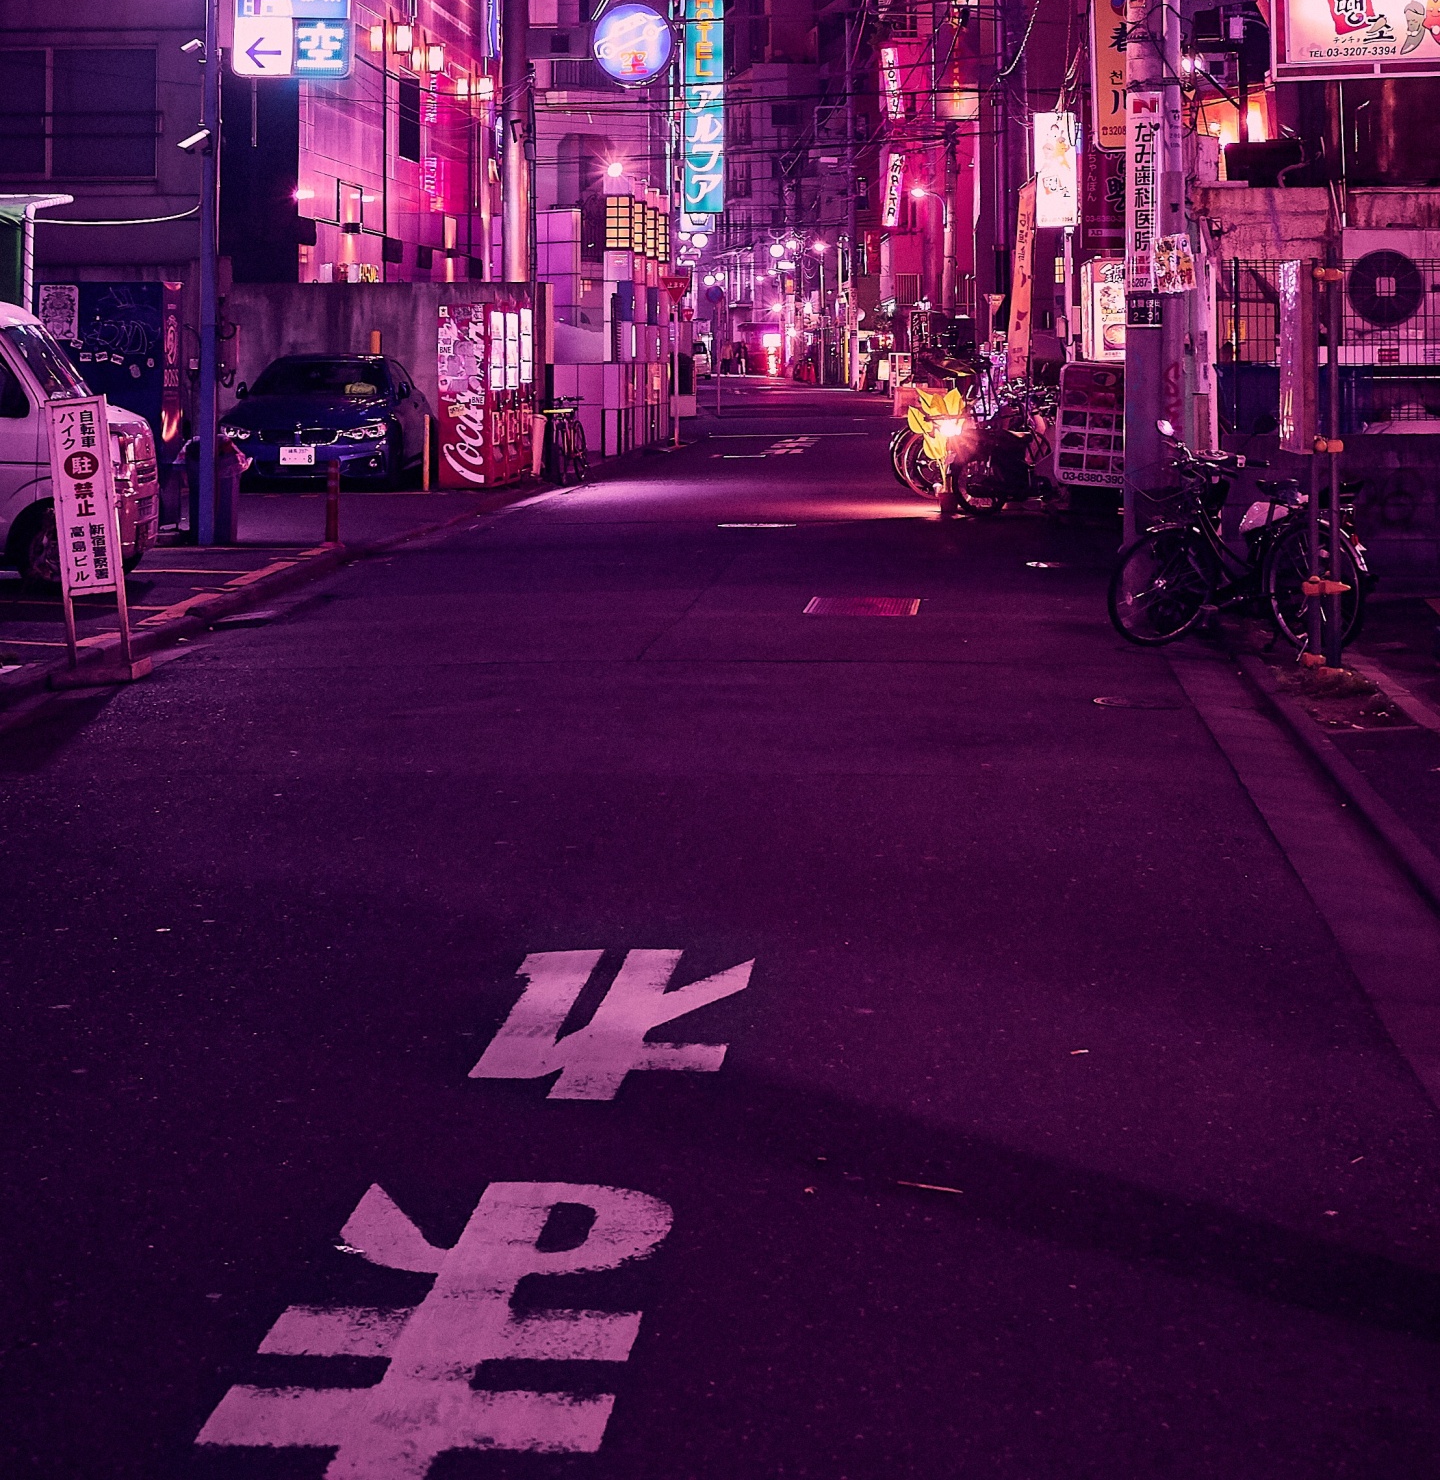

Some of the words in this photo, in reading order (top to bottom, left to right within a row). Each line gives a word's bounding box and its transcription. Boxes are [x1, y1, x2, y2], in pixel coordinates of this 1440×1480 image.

[297, 21, 344, 68] 空
[439, 346, 451, 354] BNE
[59, 412, 76, 450] バイク
[79, 410, 96, 448] 自転車
[70, 526, 90, 582] 高島ビル
[90, 524, 109, 580] 新宿警察署
